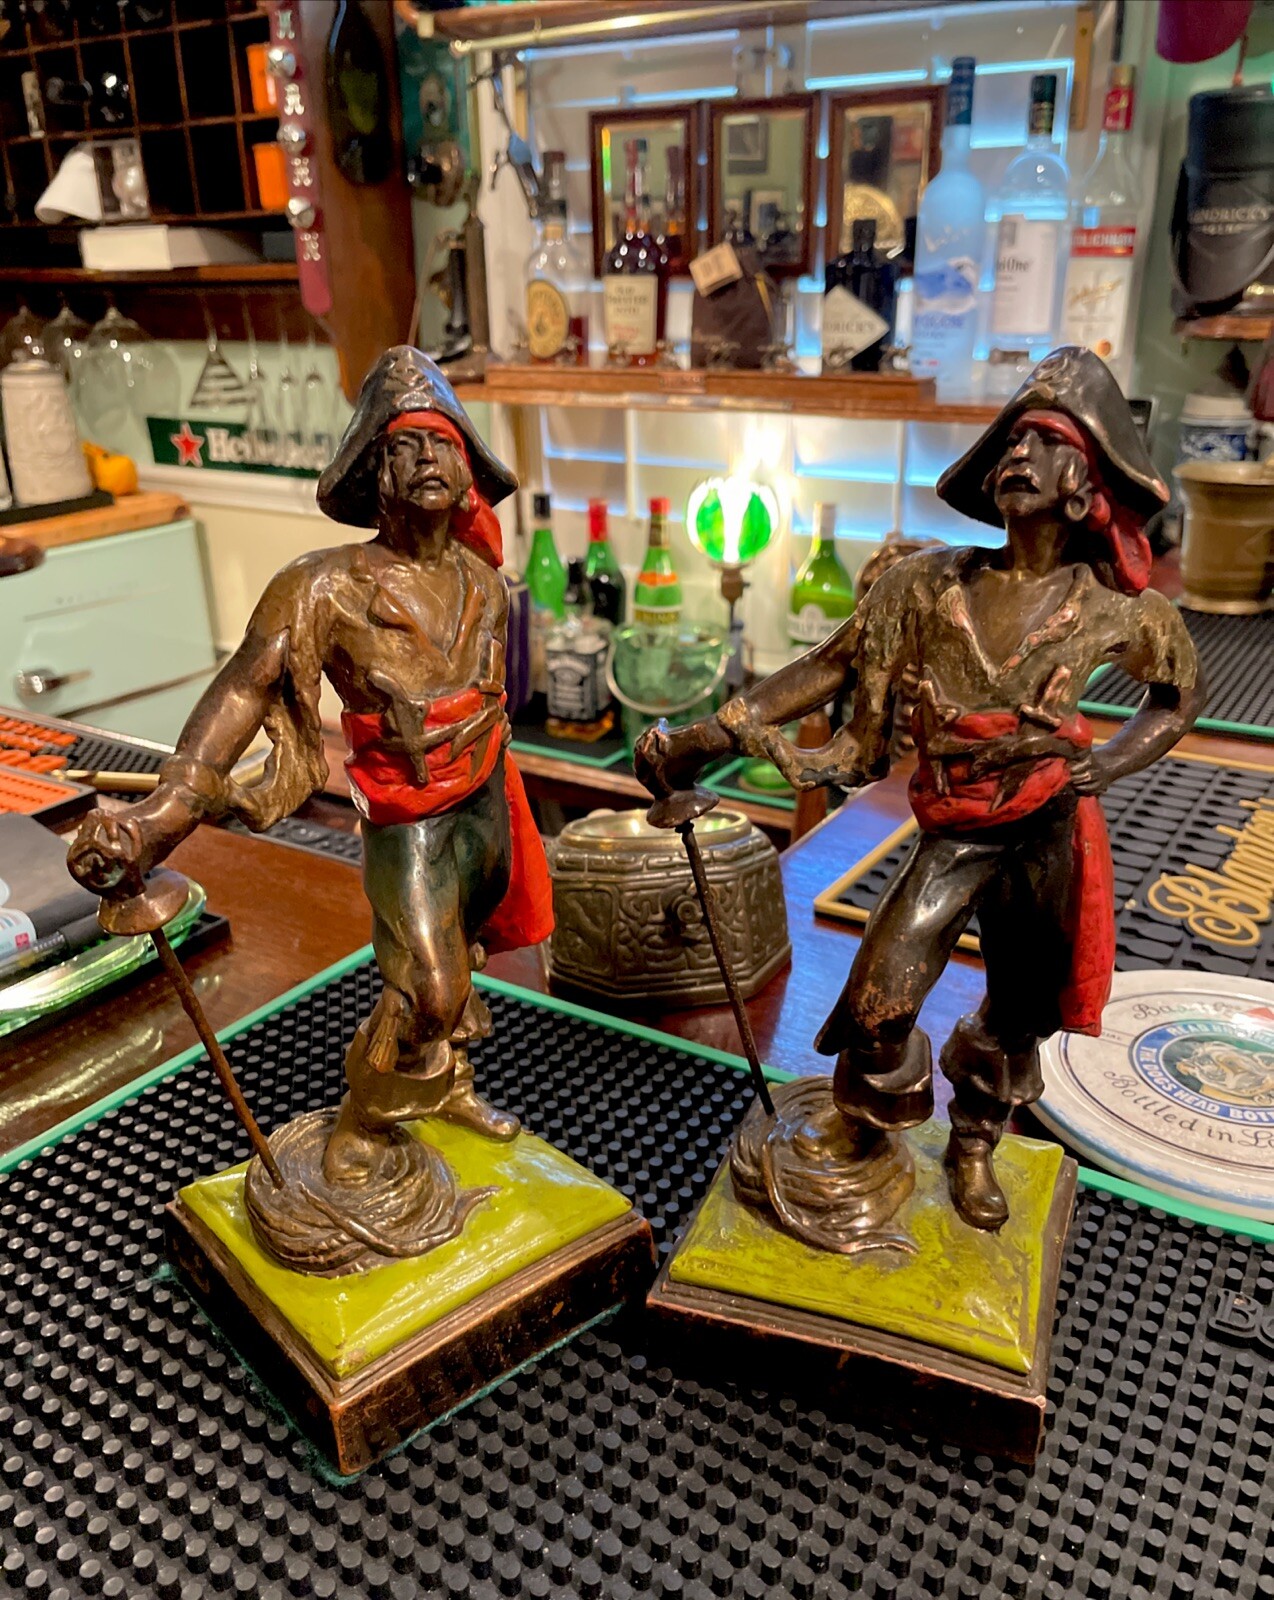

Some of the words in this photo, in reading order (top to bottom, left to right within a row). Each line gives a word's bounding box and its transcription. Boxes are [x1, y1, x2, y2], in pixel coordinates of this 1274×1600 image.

[1139, 1046, 1158, 1062] THE
[1143, 1063, 1178, 1092] DOGS
[1103, 1071, 1199, 1131] Bottled
[1207, 1126, 1234, 1143] in
[1173, 1088, 1221, 1114] HEAD
